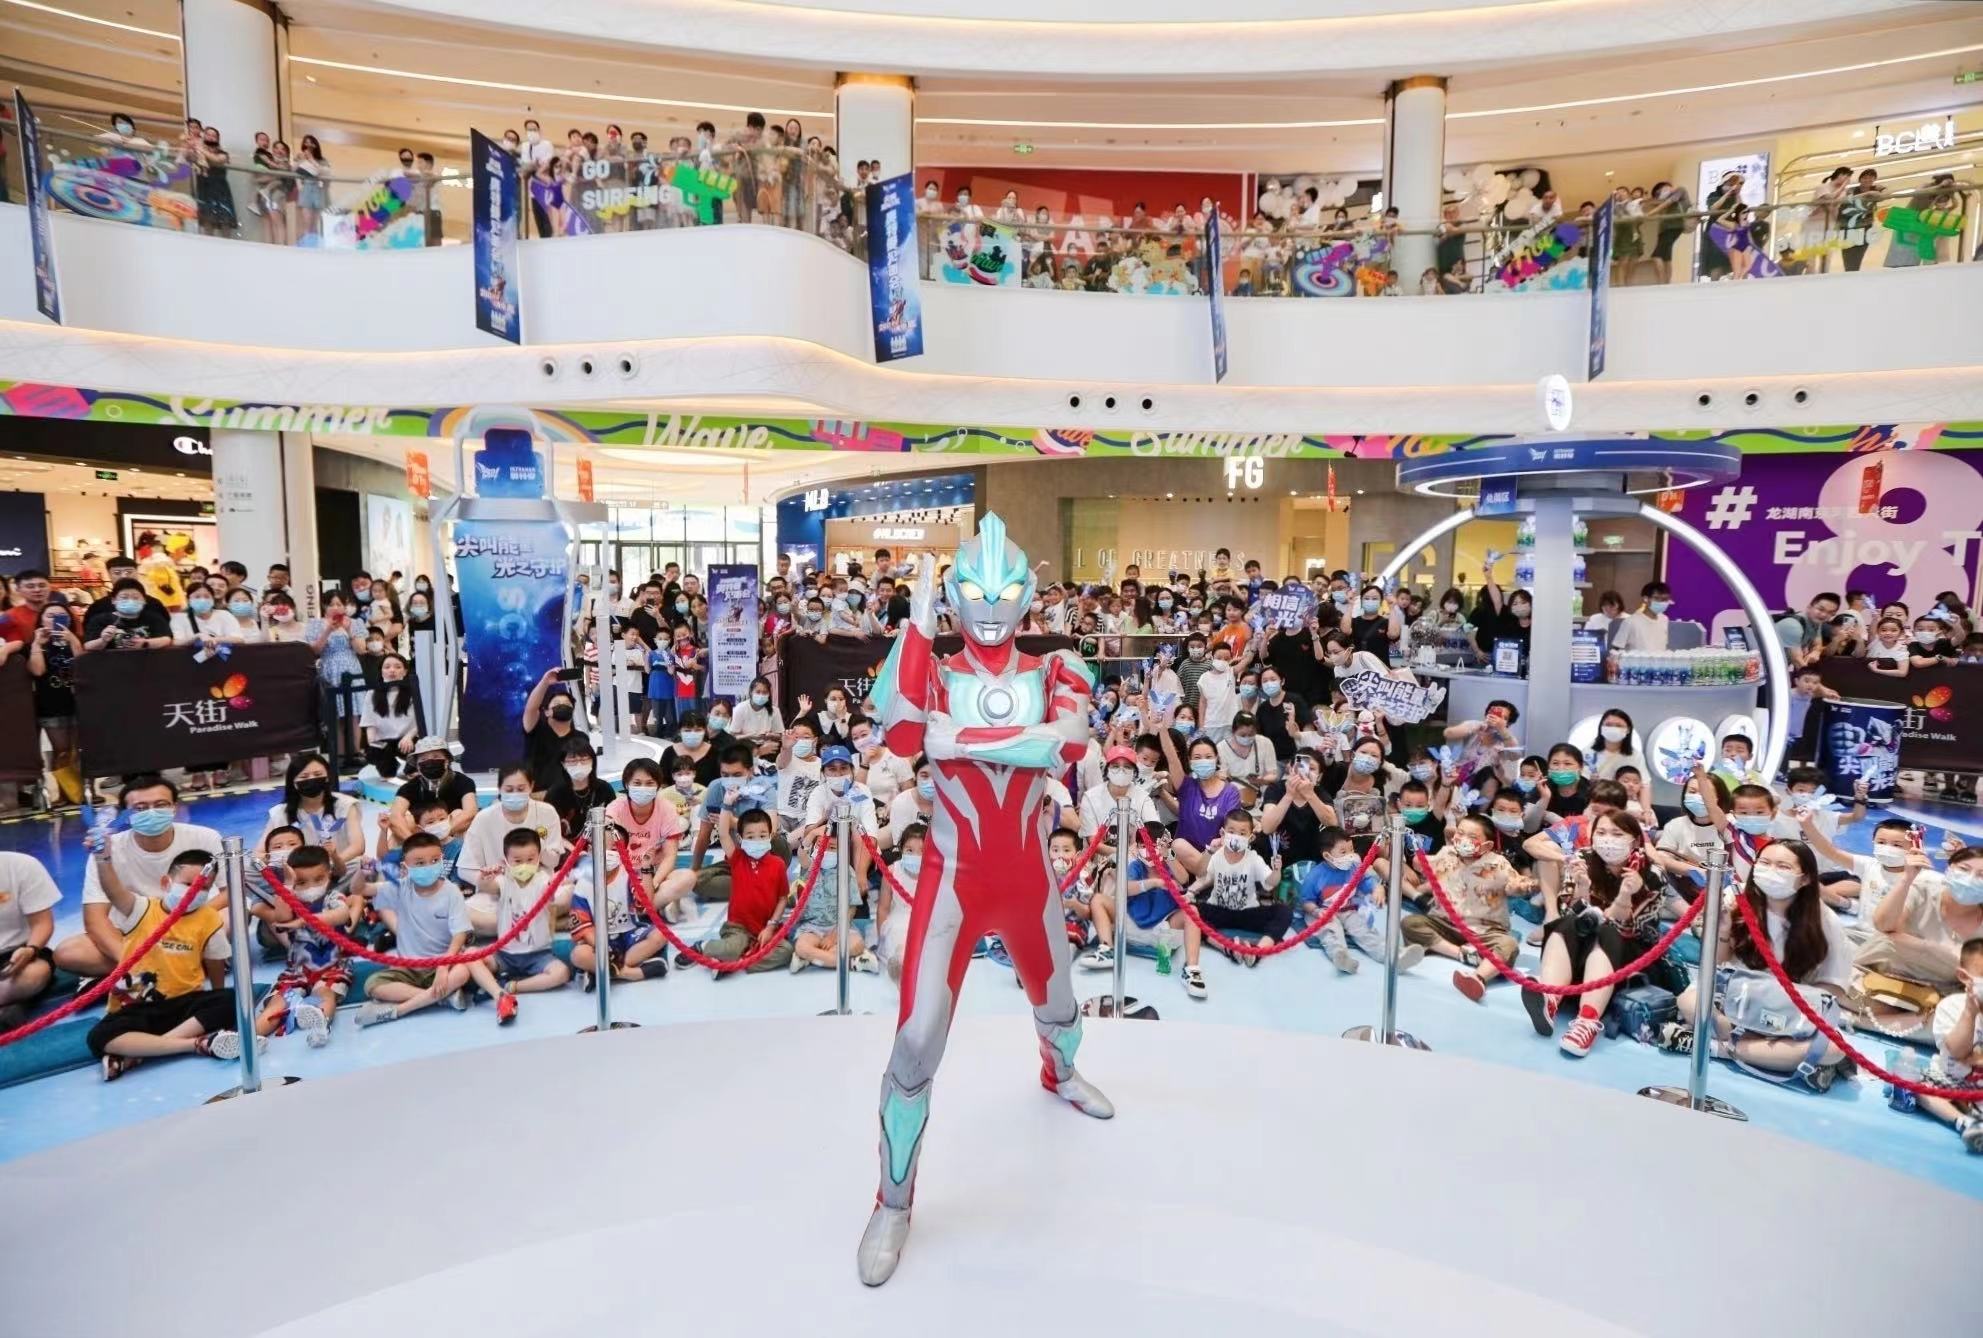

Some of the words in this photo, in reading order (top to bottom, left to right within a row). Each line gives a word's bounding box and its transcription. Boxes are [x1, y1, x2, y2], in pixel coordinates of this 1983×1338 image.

[582, 160, 610, 180] GO
[1224, 455, 1264, 489] FG
[1131, 550, 1246, 571] GREATNES
[1773, 530, 1928, 576] Enjoy
[1263, 593, 1300, 611] 相信
[163, 699, 228, 728] 天街
[189, 724, 233, 734] Paradise
[234, 720, 259, 729] Walk
[1900, 731, 1928, 740] adise
[1930, 731, 1956, 742] Walk
